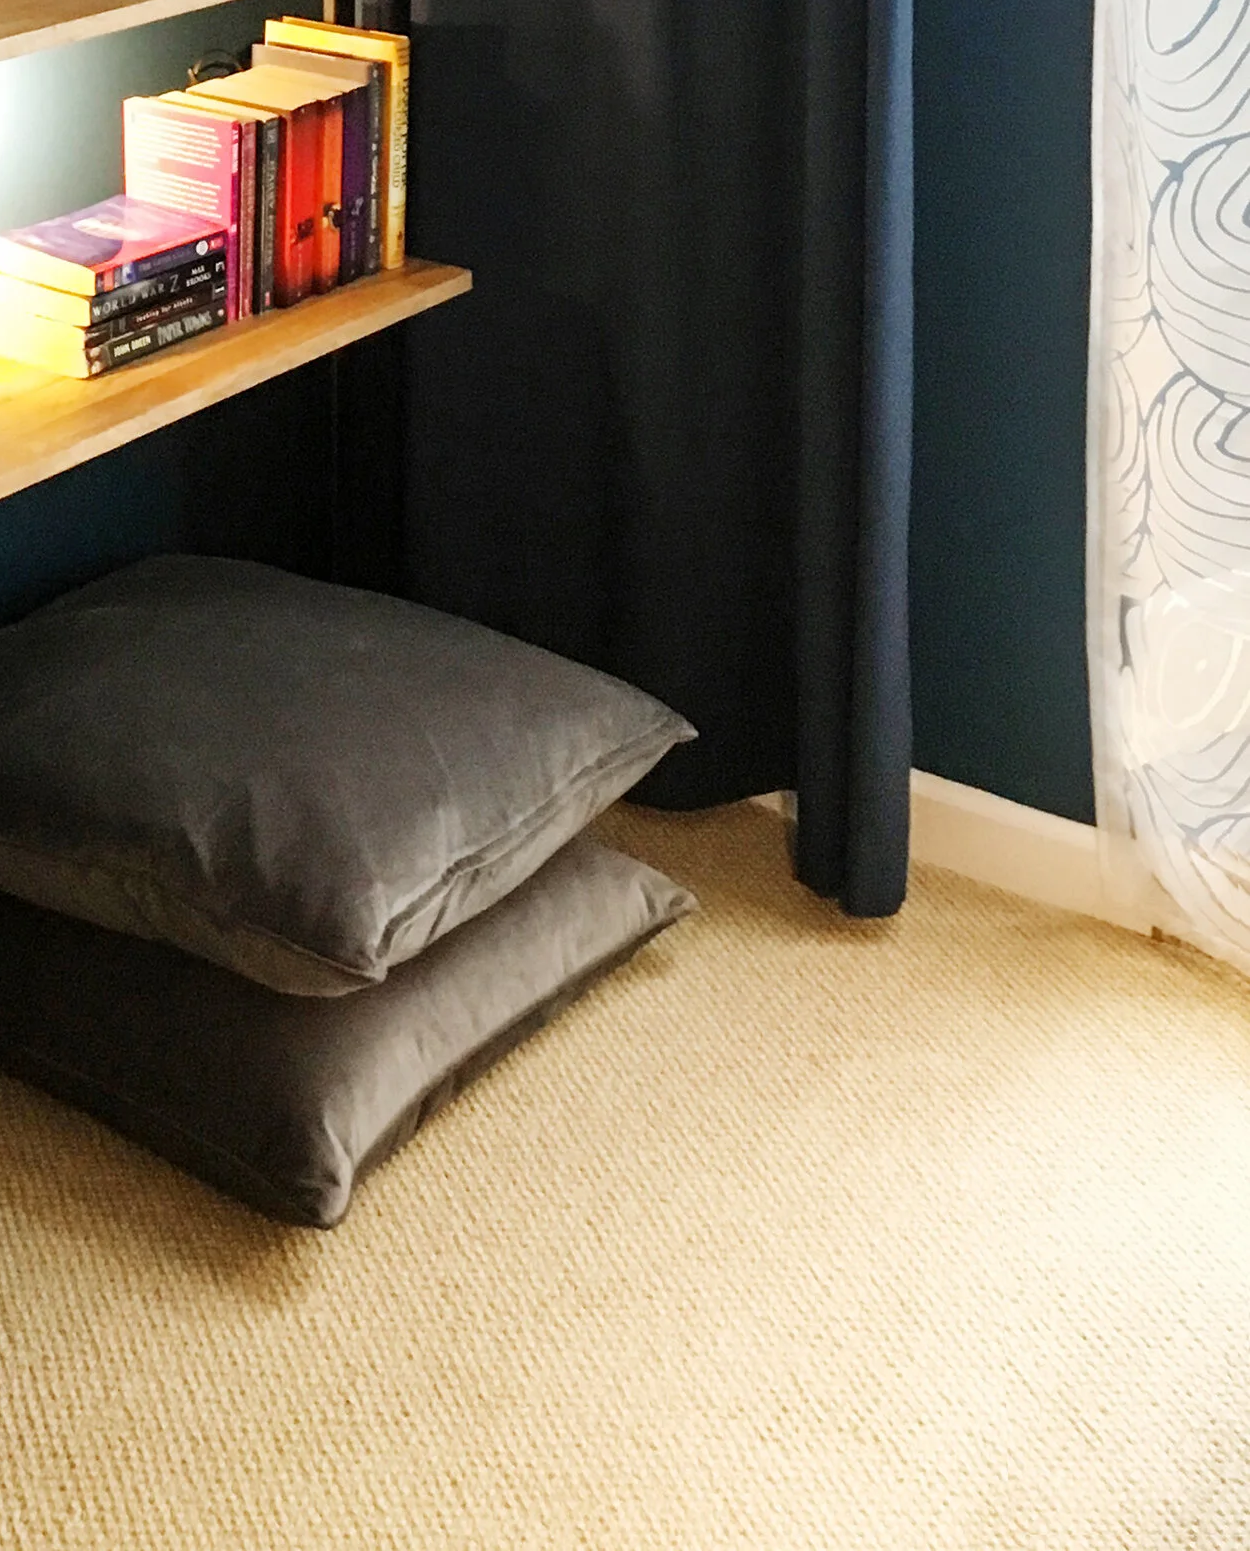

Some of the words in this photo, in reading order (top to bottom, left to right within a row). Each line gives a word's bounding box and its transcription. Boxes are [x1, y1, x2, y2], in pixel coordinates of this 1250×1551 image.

[191, 265, 205, 275] MAX
[186, 272, 212, 287] BROOKS
[92, 296, 137, 317] WORLD
[141, 283, 165, 299] WAR
[169, 274, 181, 293] Z
[161, 304, 171, 313] for
[131, 335, 151, 350] GREEN
